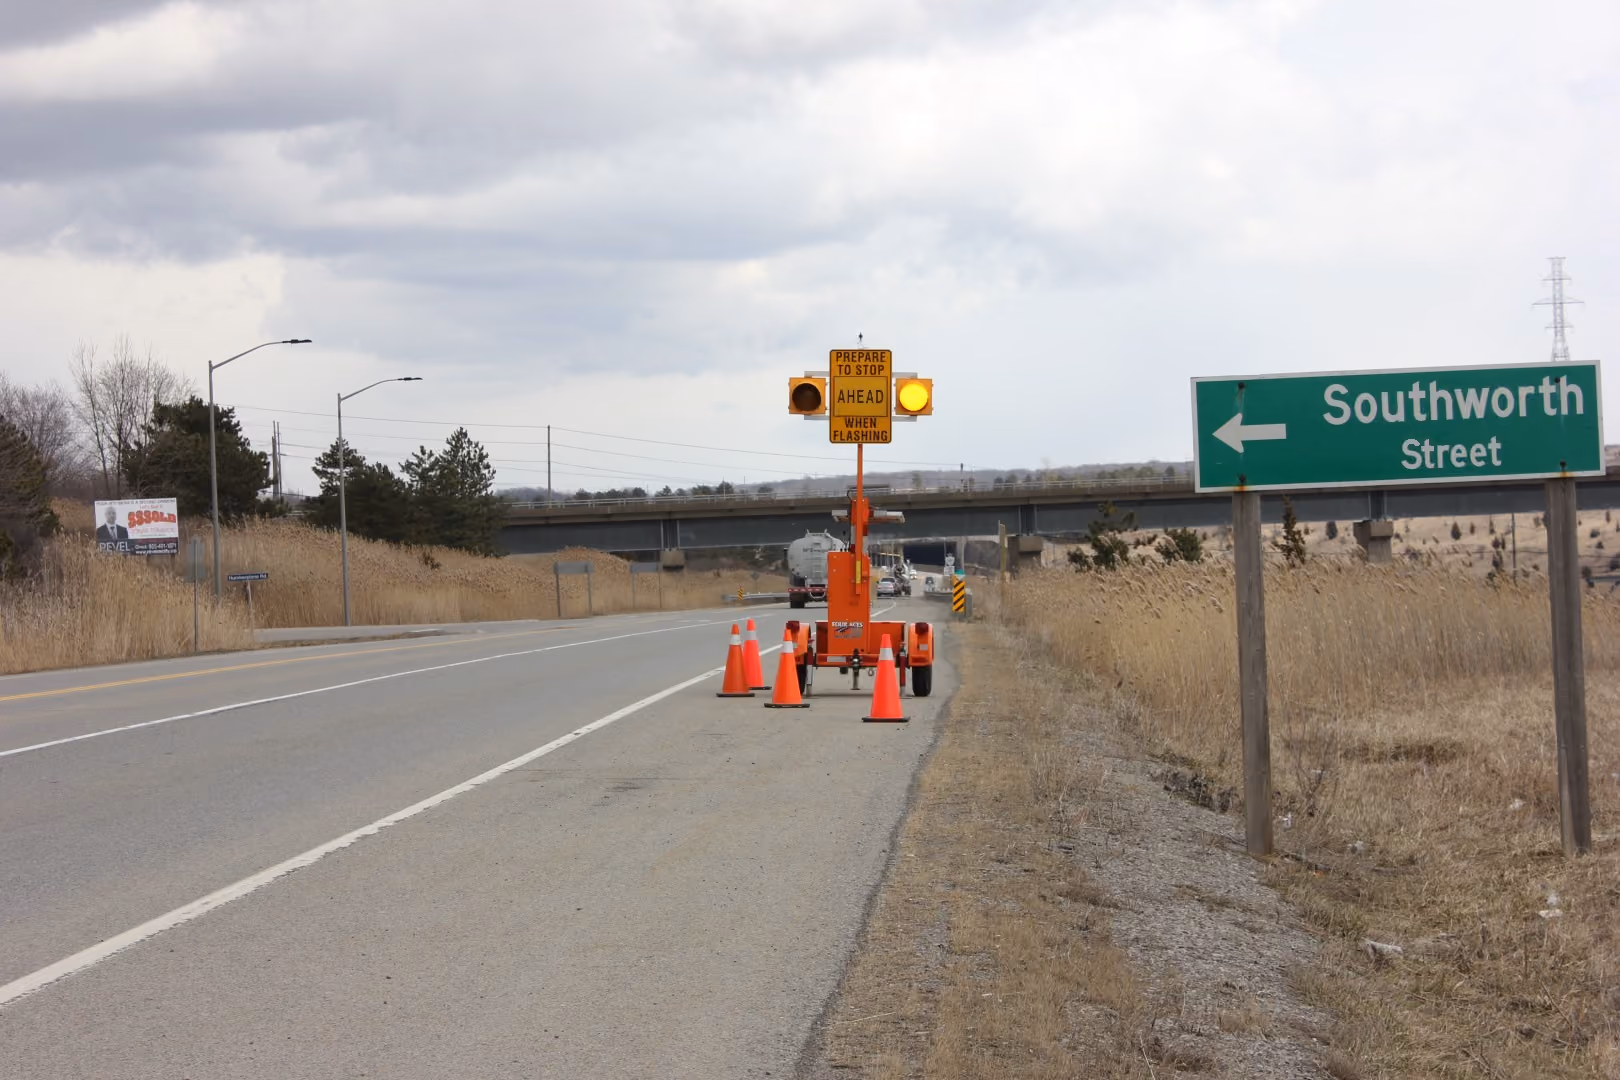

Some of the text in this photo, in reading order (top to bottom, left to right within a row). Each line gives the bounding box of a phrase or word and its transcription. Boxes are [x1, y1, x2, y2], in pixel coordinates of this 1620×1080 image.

[836, 352, 886, 362] PREPARE
[838, 364, 885, 375] TO STOP
[837, 389, 884, 404] AHEAD
[1323, 375, 1583, 425] Southworth
[844, 417, 877, 428] WHEN
[833, 430, 888, 441] FLASHING
[1401, 436, 1502, 470] Street
